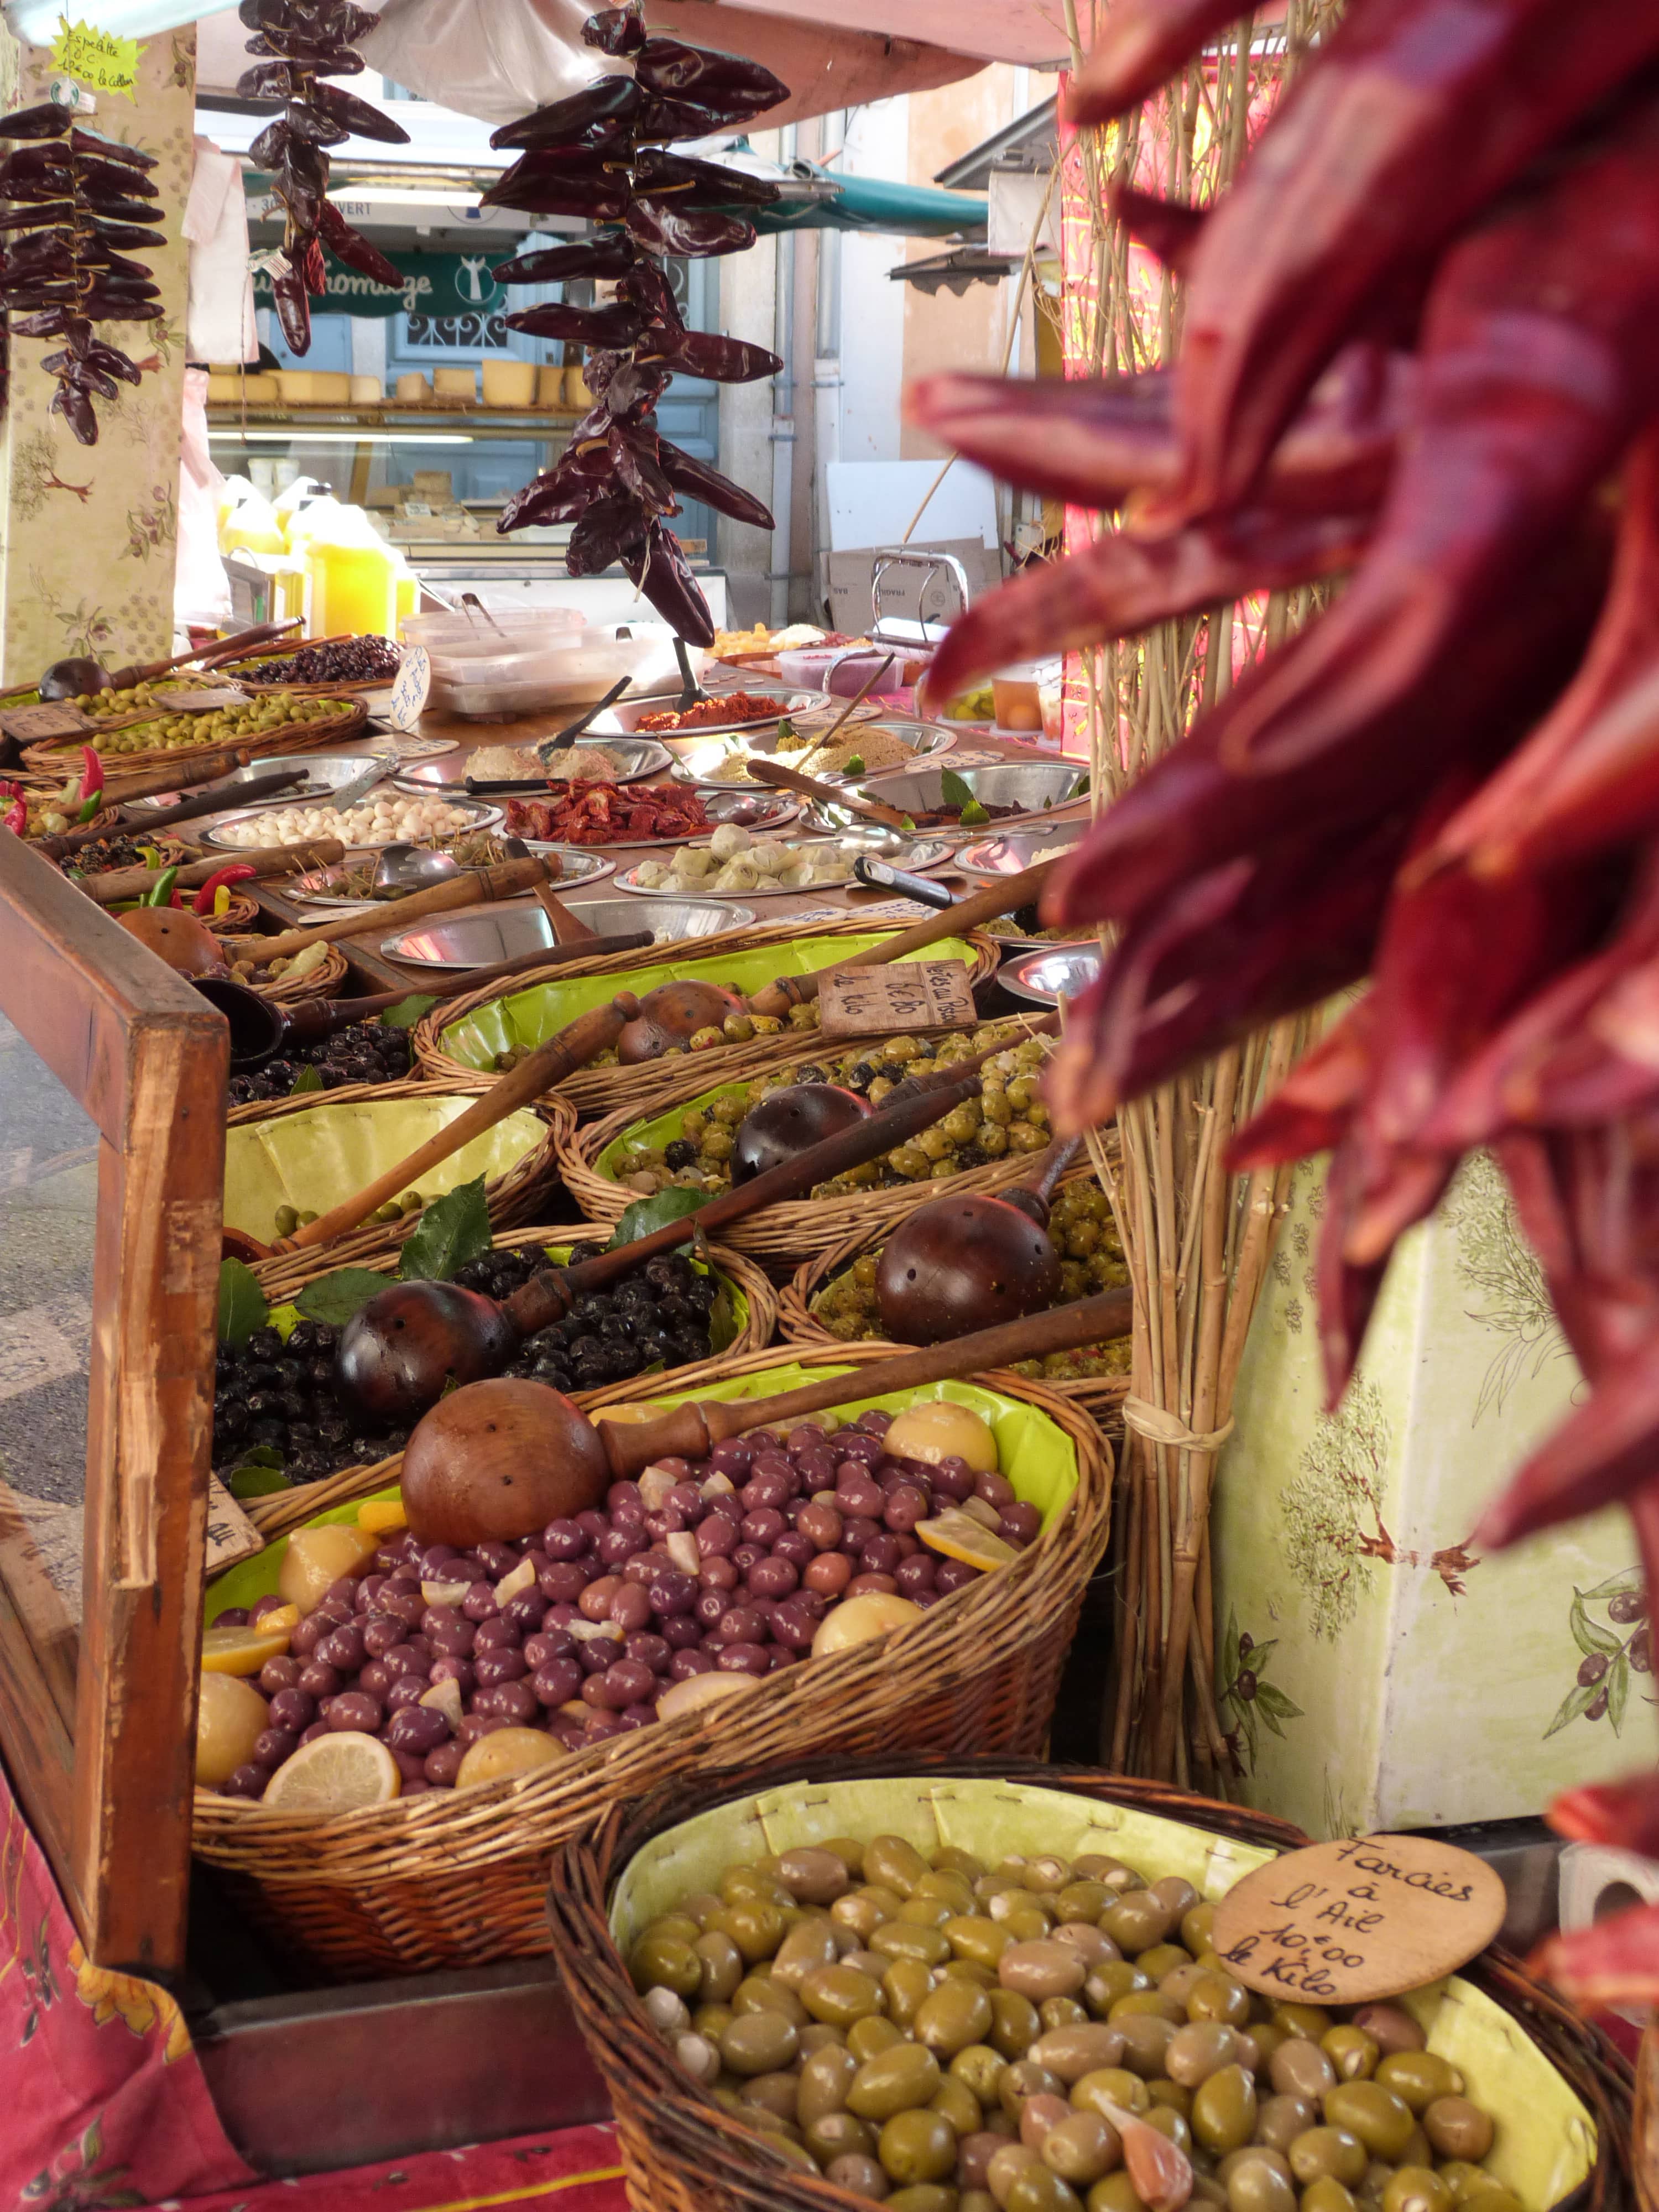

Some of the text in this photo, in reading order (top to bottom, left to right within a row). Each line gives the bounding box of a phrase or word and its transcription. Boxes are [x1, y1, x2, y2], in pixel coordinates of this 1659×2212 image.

[833, 973, 875, 988] le
[932, 988, 952, 1000] au
[1337, 1838, 1473, 1901] Farcies
[1347, 1882, 1380, 1901] à
[1218, 1936, 1260, 1966] le
